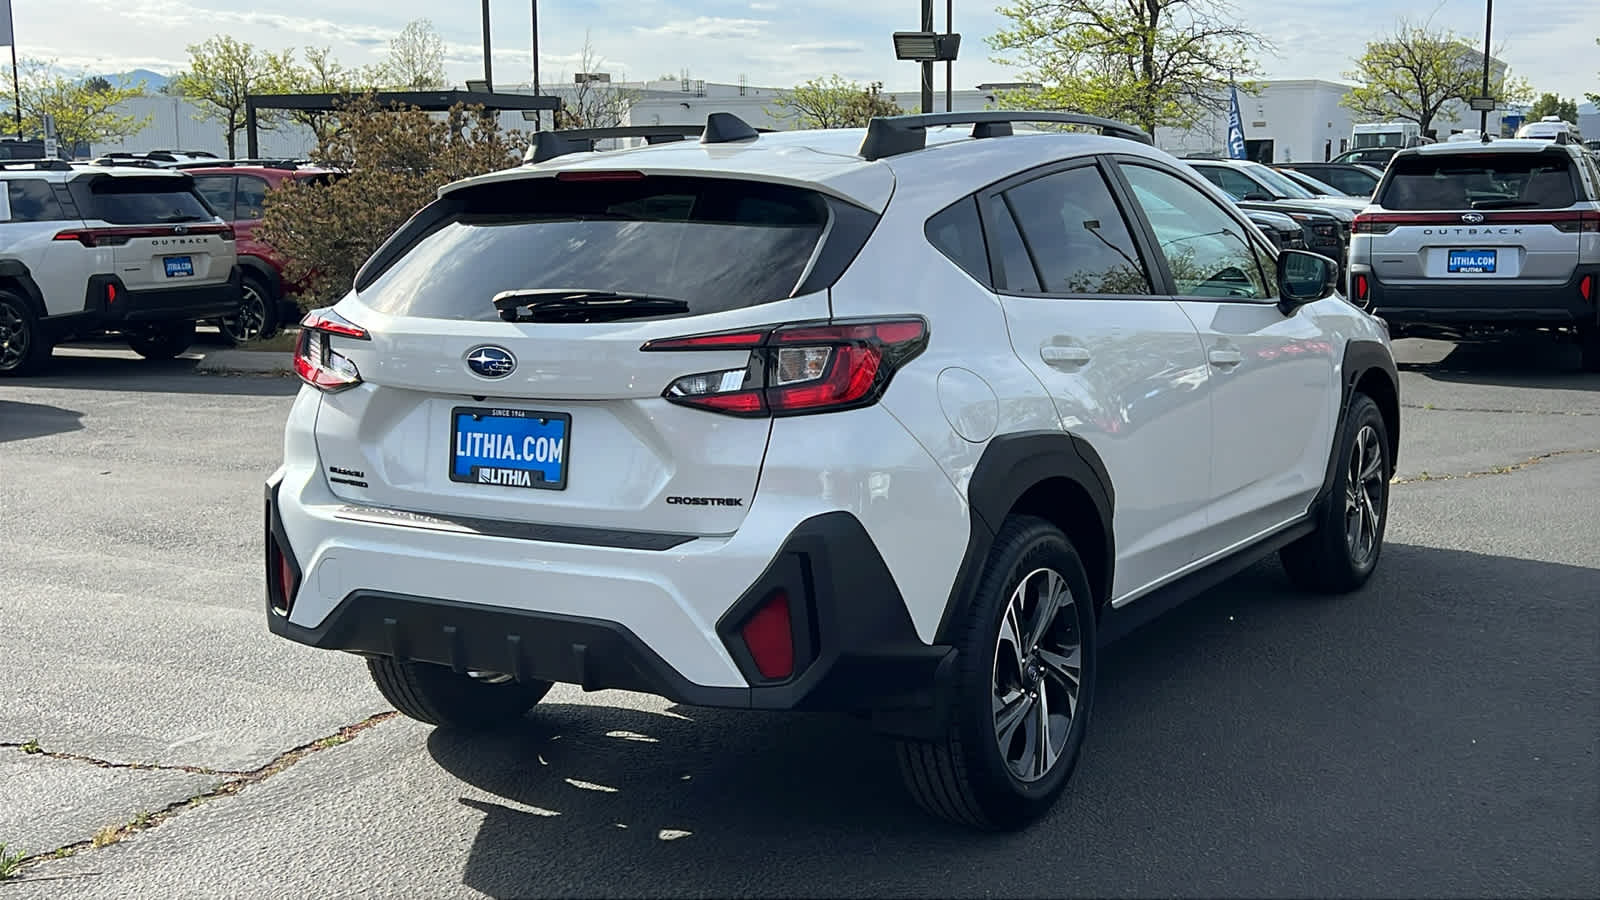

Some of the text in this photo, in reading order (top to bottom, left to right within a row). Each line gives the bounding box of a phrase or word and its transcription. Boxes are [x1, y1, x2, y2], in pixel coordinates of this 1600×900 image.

[1450, 256, 1495, 266] LITHIA.COM
[492, 409, 510, 417] SINCE
[456, 431, 563, 463] LITHIA.COM
[490, 468, 531, 487] LITHIA
[666, 496, 743, 507] CROSSTREK
